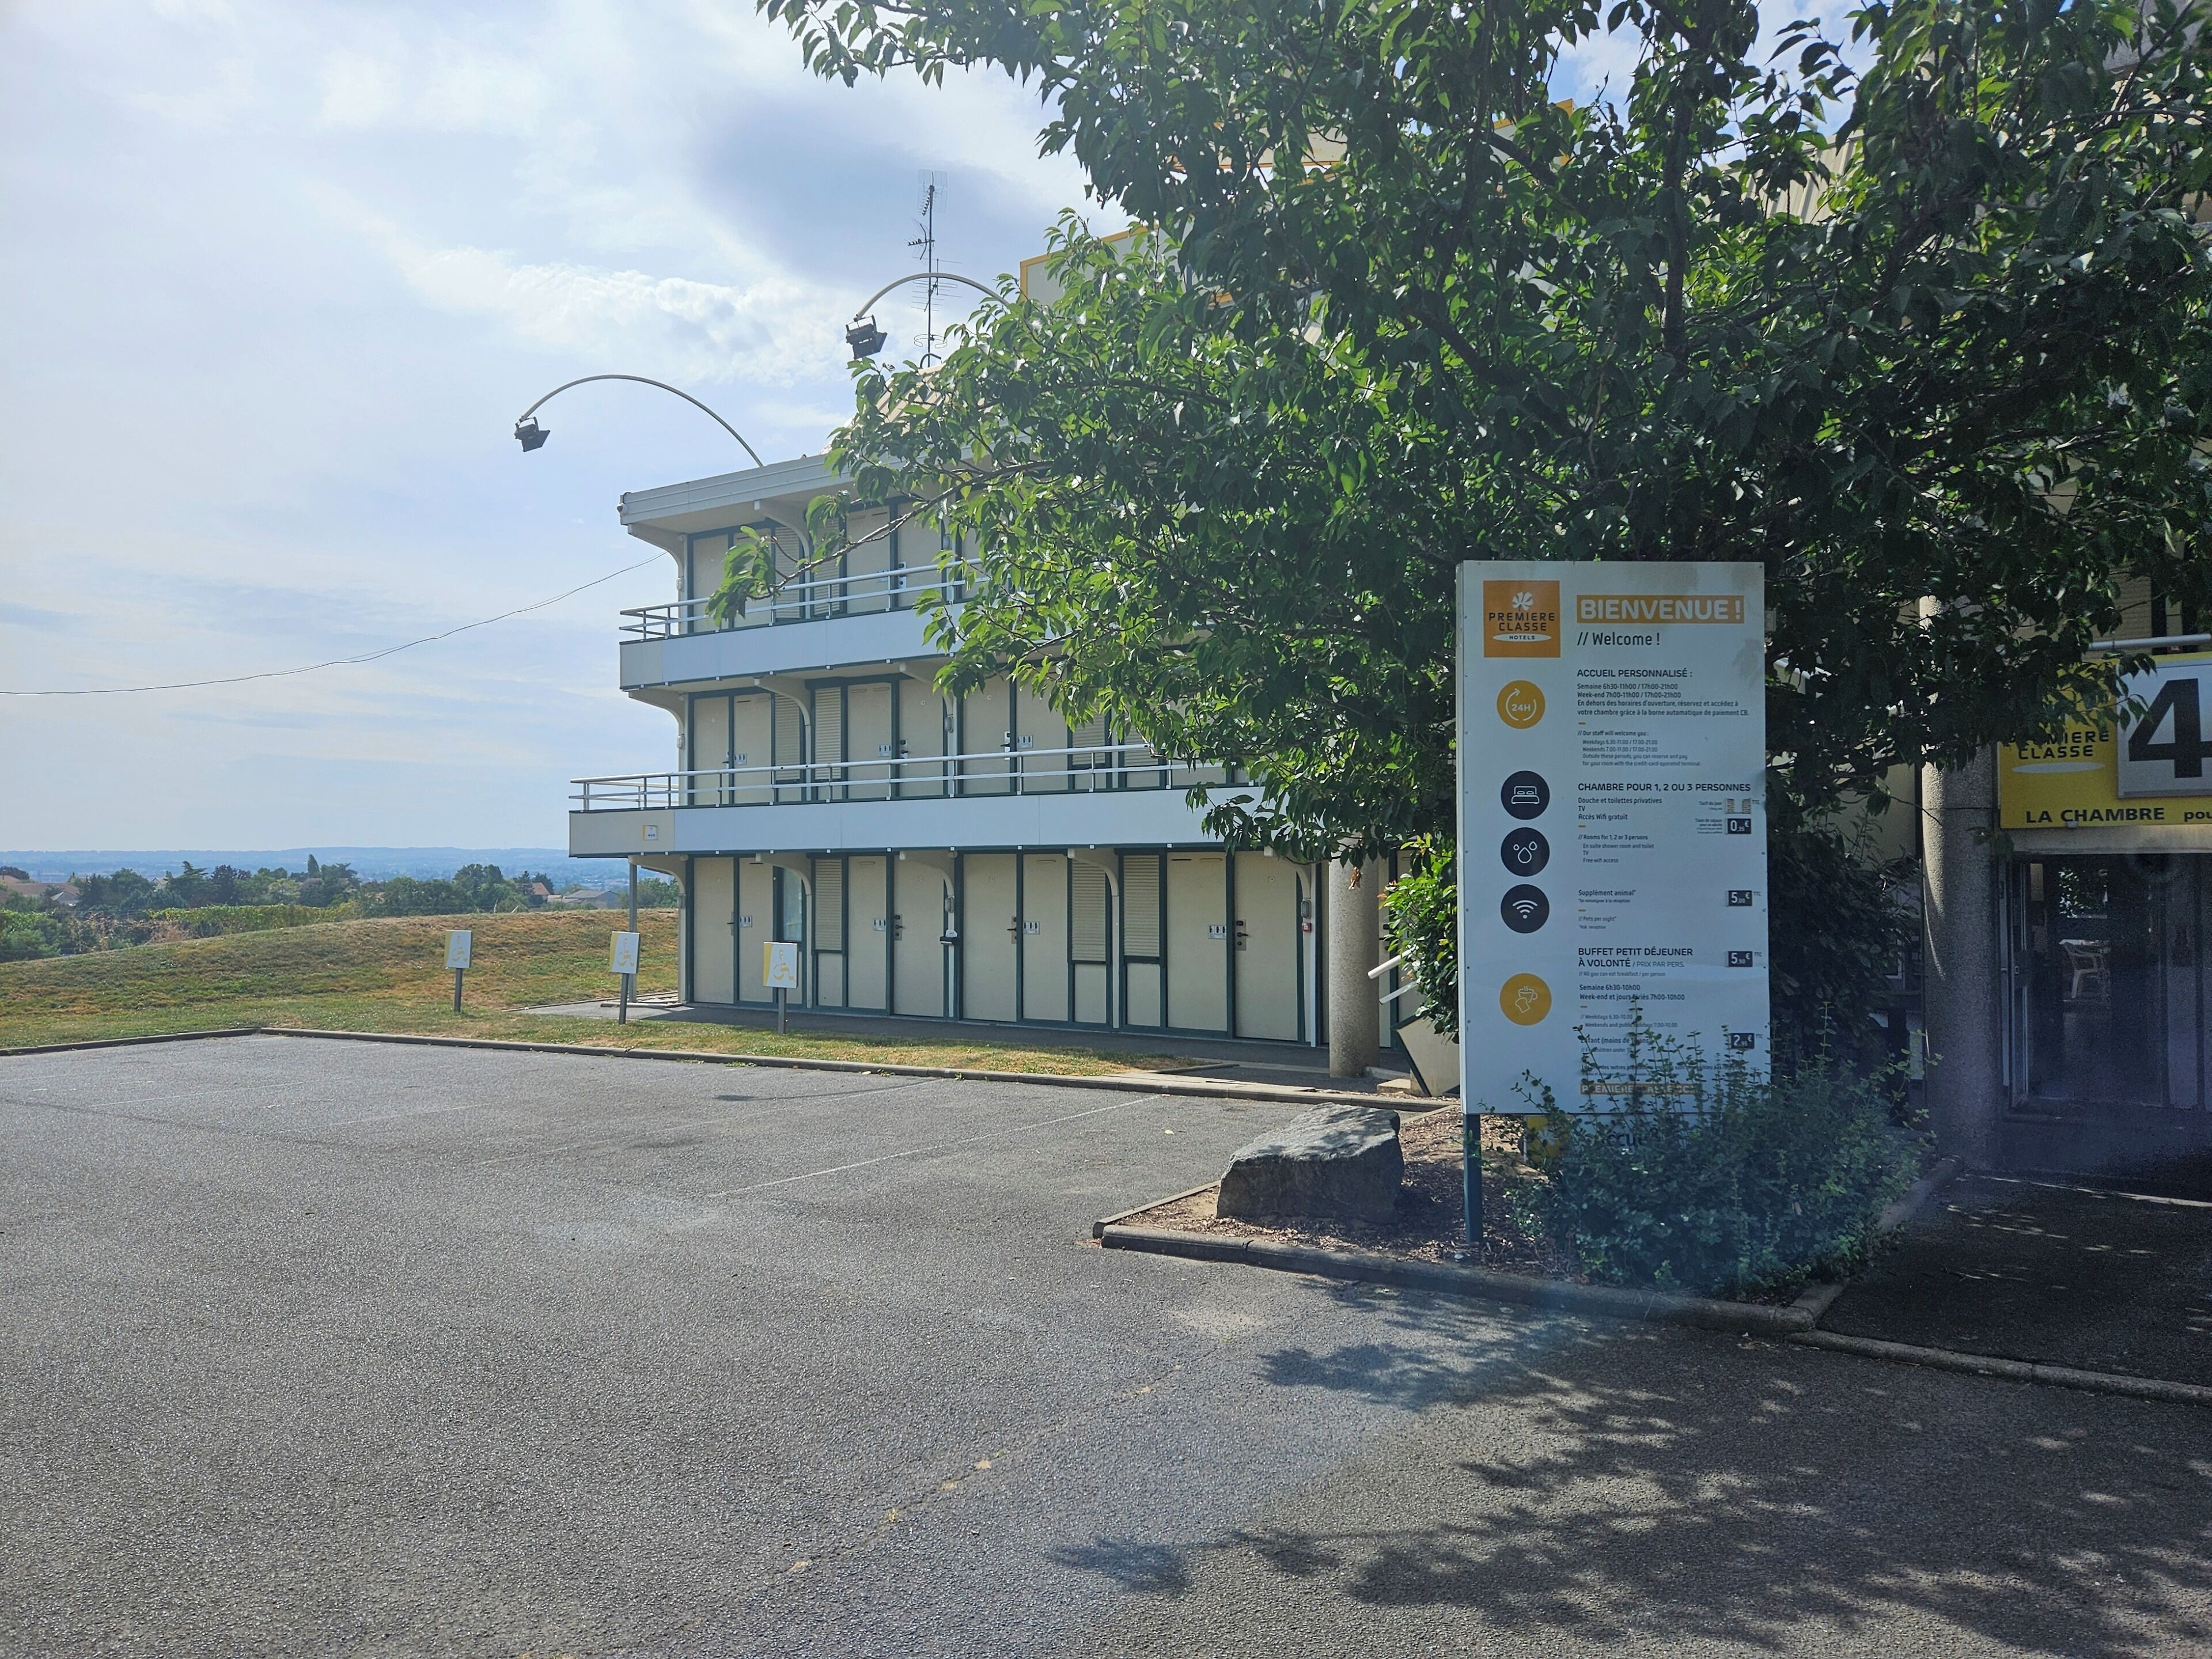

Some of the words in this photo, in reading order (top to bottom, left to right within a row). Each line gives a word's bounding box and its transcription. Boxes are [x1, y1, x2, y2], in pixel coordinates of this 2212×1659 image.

[1581, 599, 1729, 620] BIENVENUE
[1489, 612, 1555, 622] PREMIERE
[1499, 622, 1547, 631] CLASSE
[1592, 632, 1652, 646] Welcome
[1657, 632, 1660, 646] !
[1619, 668, 1687, 677] PERSONNALISÉ
[2018, 745, 2093, 759] CLASSE
[2026, 811, 2052, 823] LA
[2061, 808, 2164, 821] CHAMBRE
[1645, 946, 1692, 956] DÉJEUNER
[1578, 957, 1585, 967] À
[1587, 957, 1630, 967] VOLONTÉ
